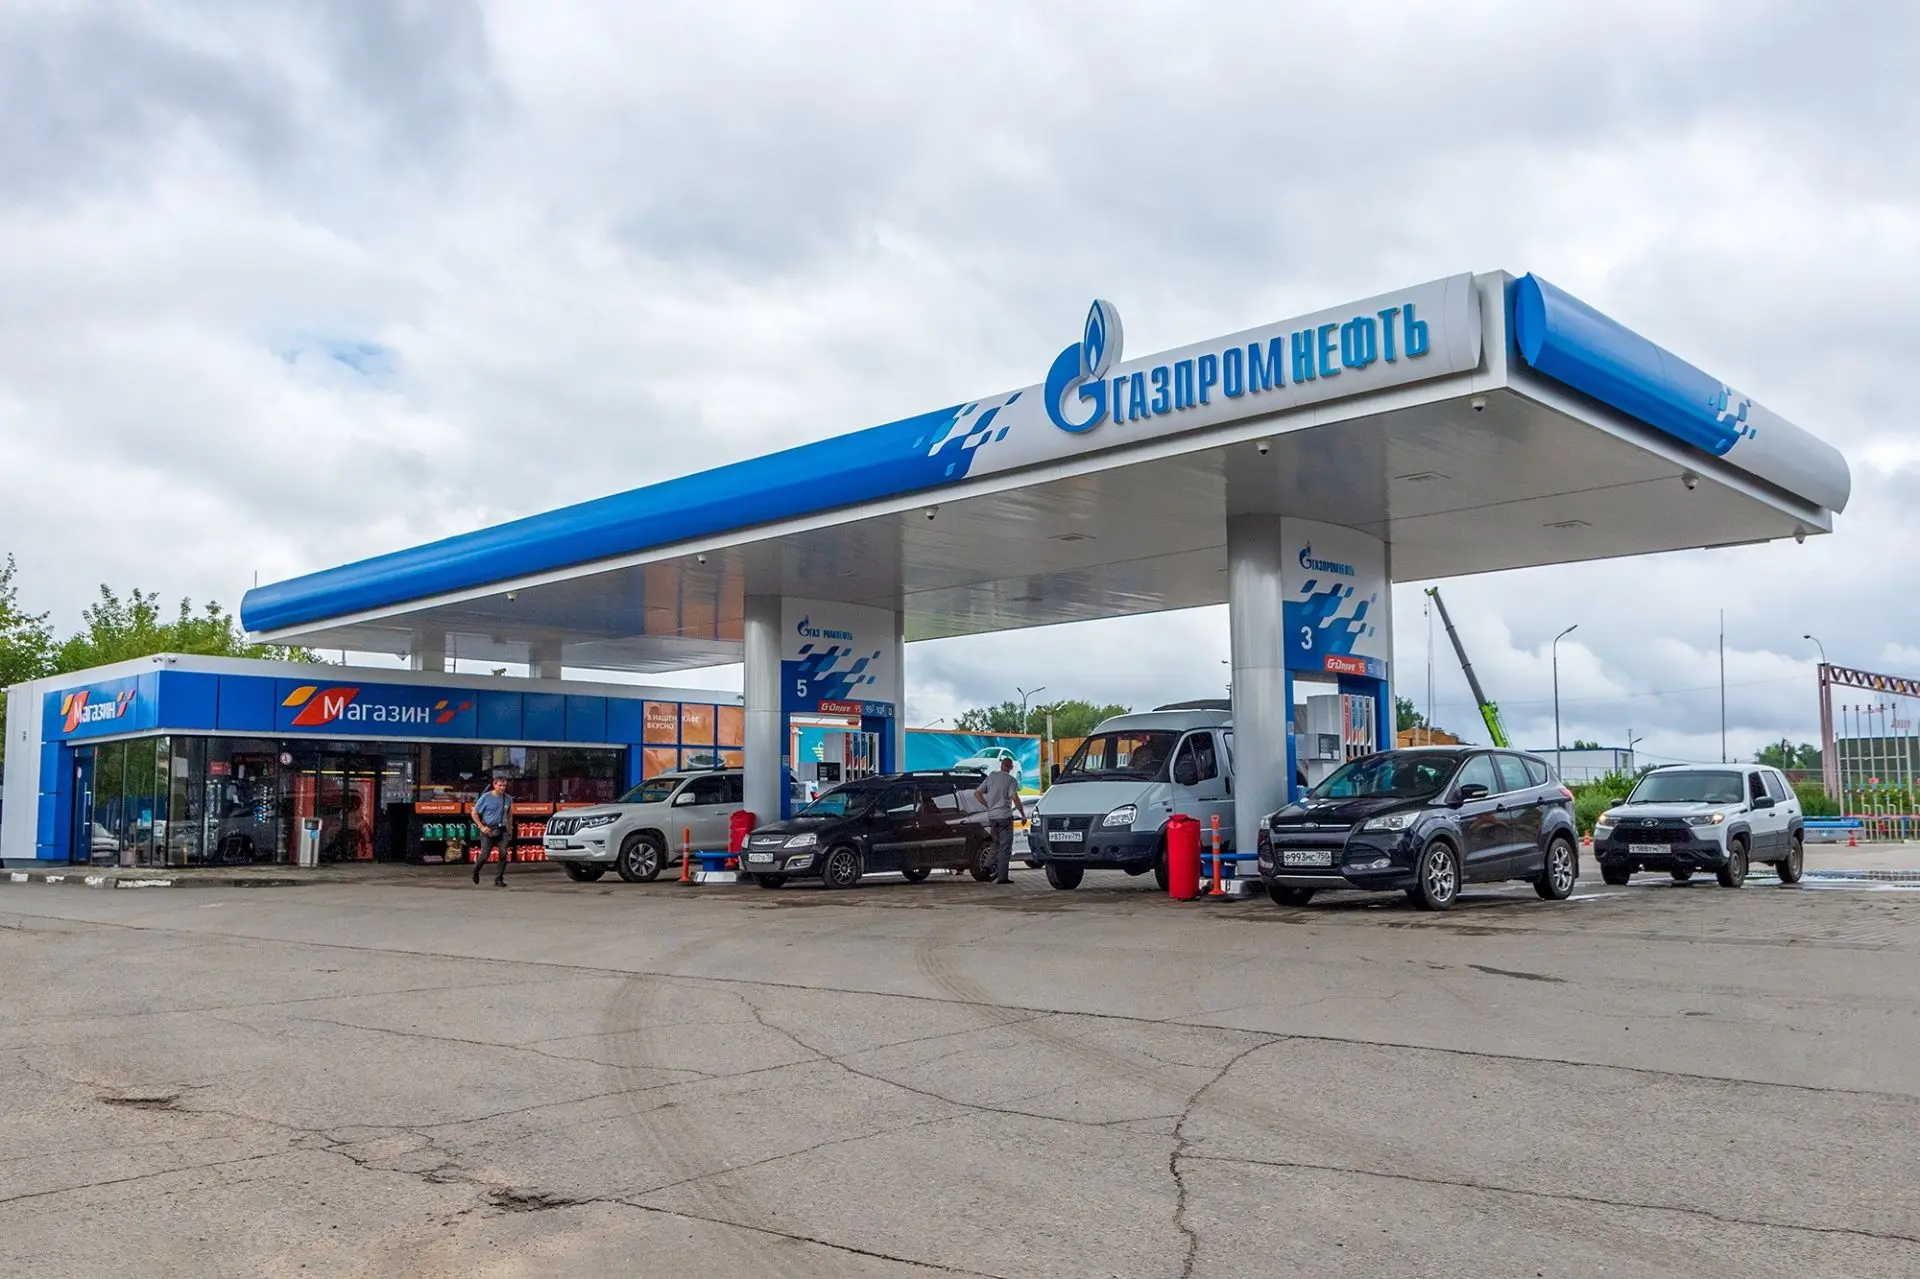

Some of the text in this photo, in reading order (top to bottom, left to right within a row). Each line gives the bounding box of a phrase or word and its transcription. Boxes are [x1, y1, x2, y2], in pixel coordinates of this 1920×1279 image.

[1112, 303, 1431, 425] ГАЗПРОМНЕФТЬ
[1301, 626, 1312, 649] 3
[797, 680, 807, 697] 5
[74, 701, 116, 723] Магазин
[323, 695, 430, 723] Магазин
